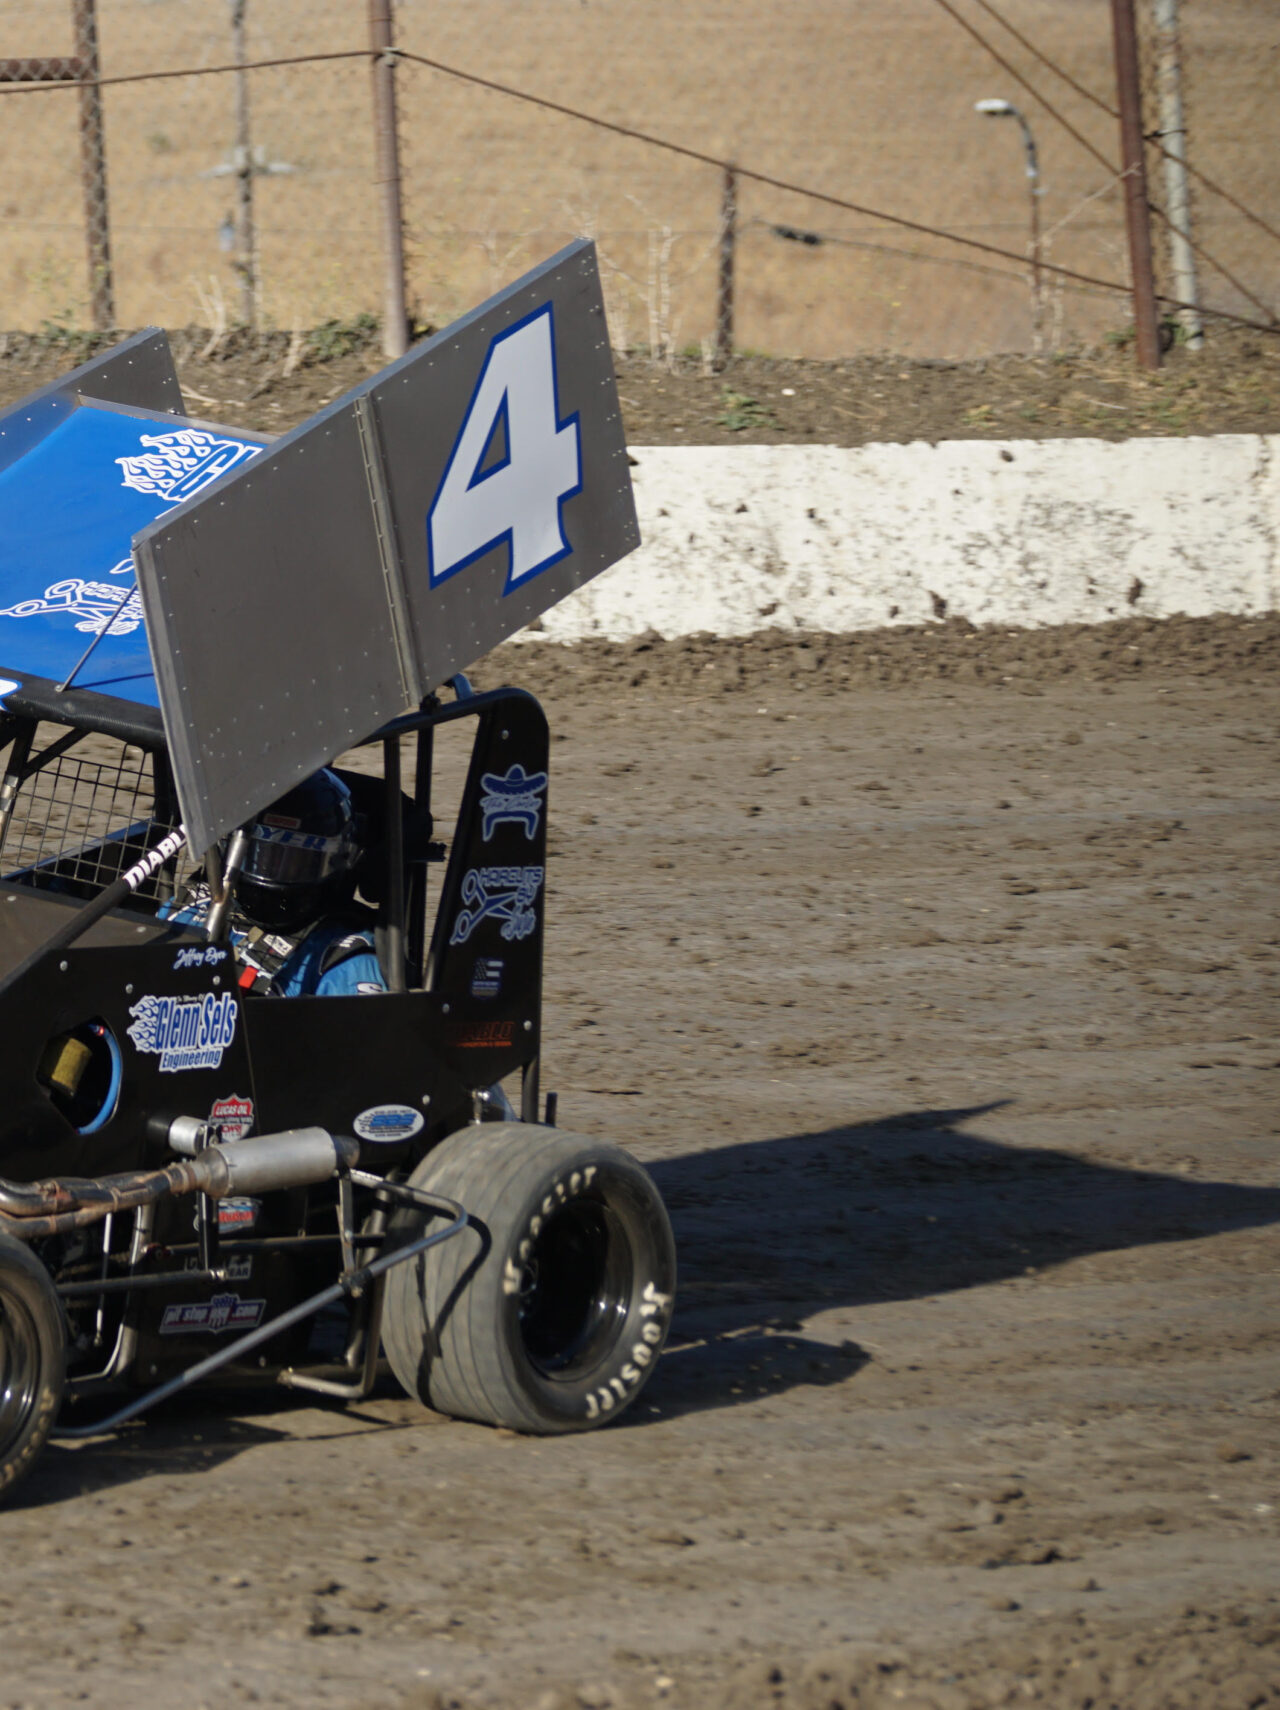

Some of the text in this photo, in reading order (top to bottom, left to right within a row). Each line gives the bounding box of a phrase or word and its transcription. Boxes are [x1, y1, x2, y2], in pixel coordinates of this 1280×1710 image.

[427, 300, 583, 598] 4
[156, 993, 236, 1050] Glenn Sels
[161, 1049, 222, 1069] Engineering
[215, 1104, 248, 1116] LUCAS OIL
